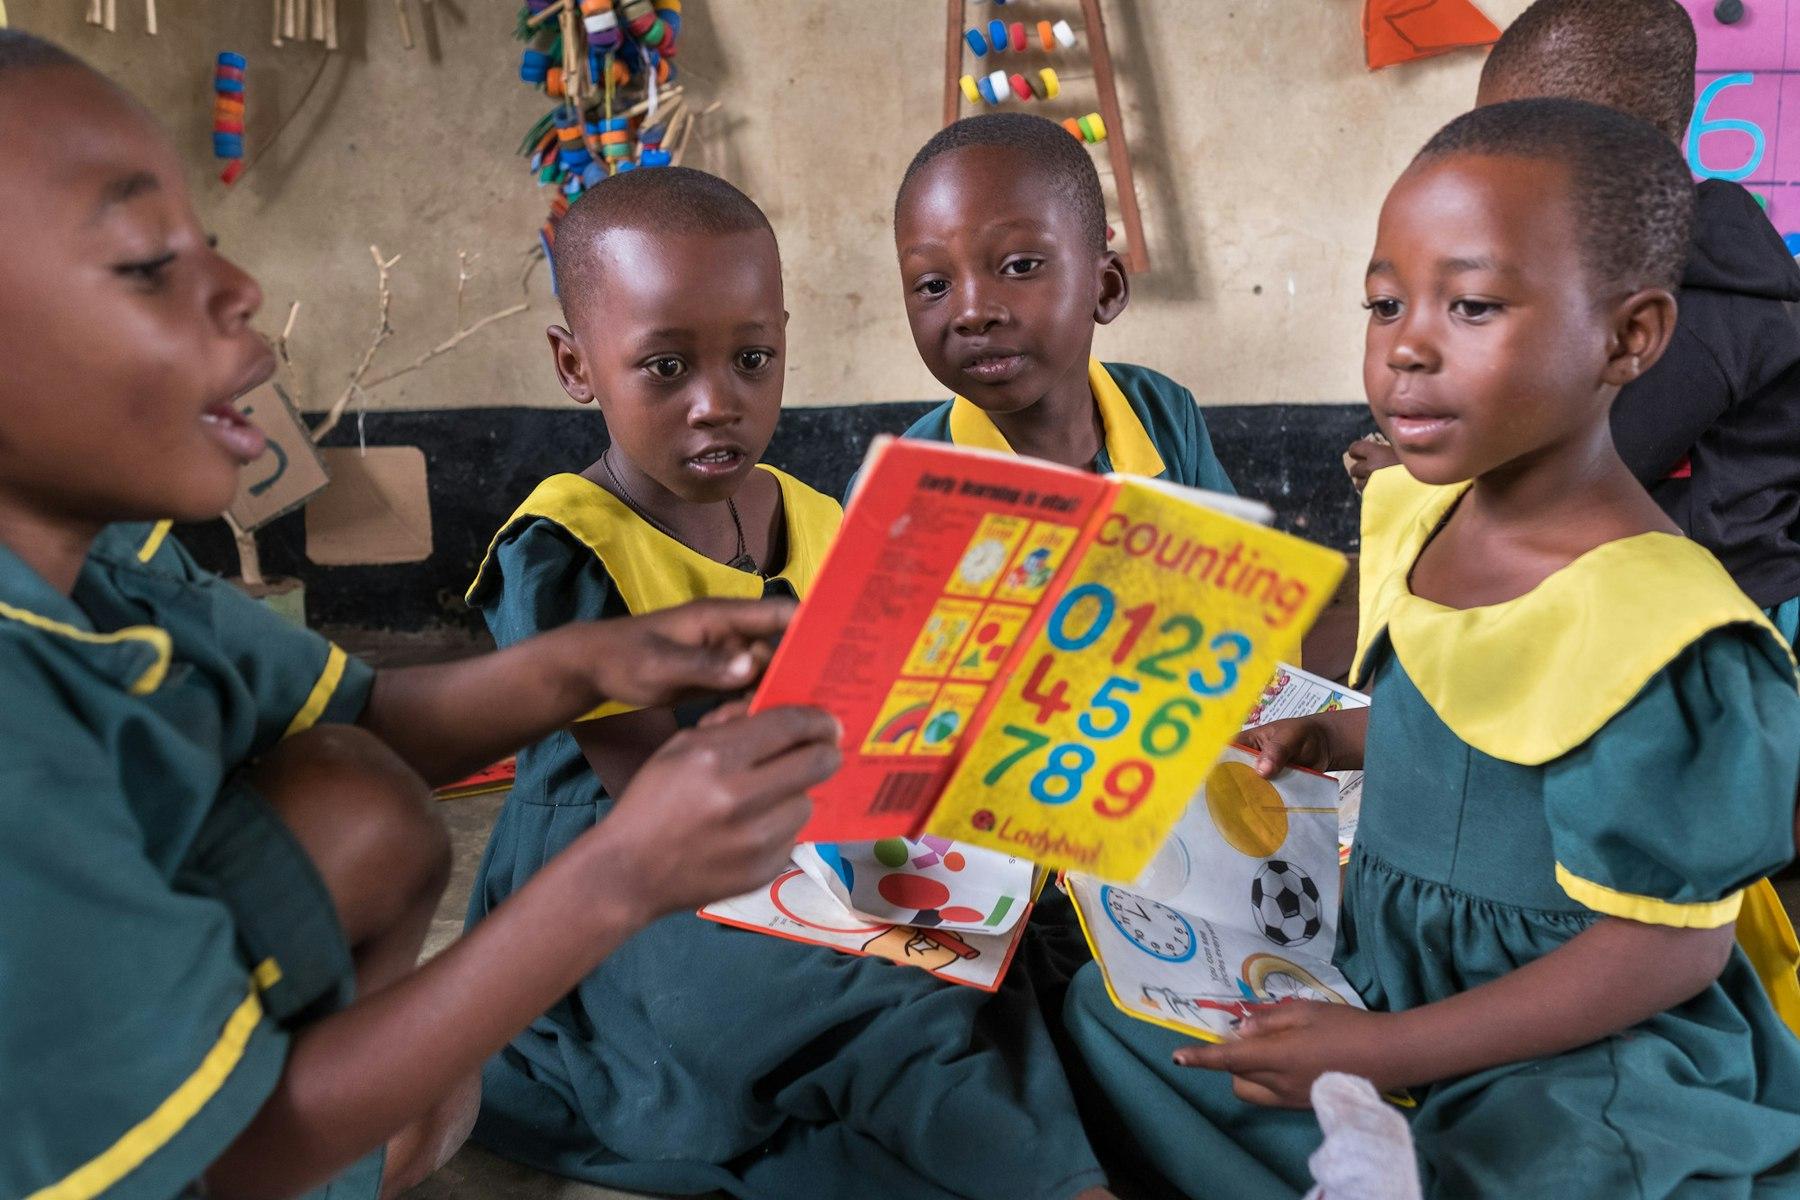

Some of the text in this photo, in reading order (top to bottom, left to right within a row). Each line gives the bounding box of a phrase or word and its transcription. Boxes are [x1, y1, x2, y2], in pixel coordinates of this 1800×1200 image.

[1687, 71, 1765, 183] 6
[1096, 513, 1308, 629] counting
[1047, 583, 1253, 698] 0 1 2 3
[1020, 653, 1071, 726] 4
[1077, 677, 1141, 740] 5
[1139, 696, 1202, 758] 6
[983, 724, 1156, 820] 7 8 9
